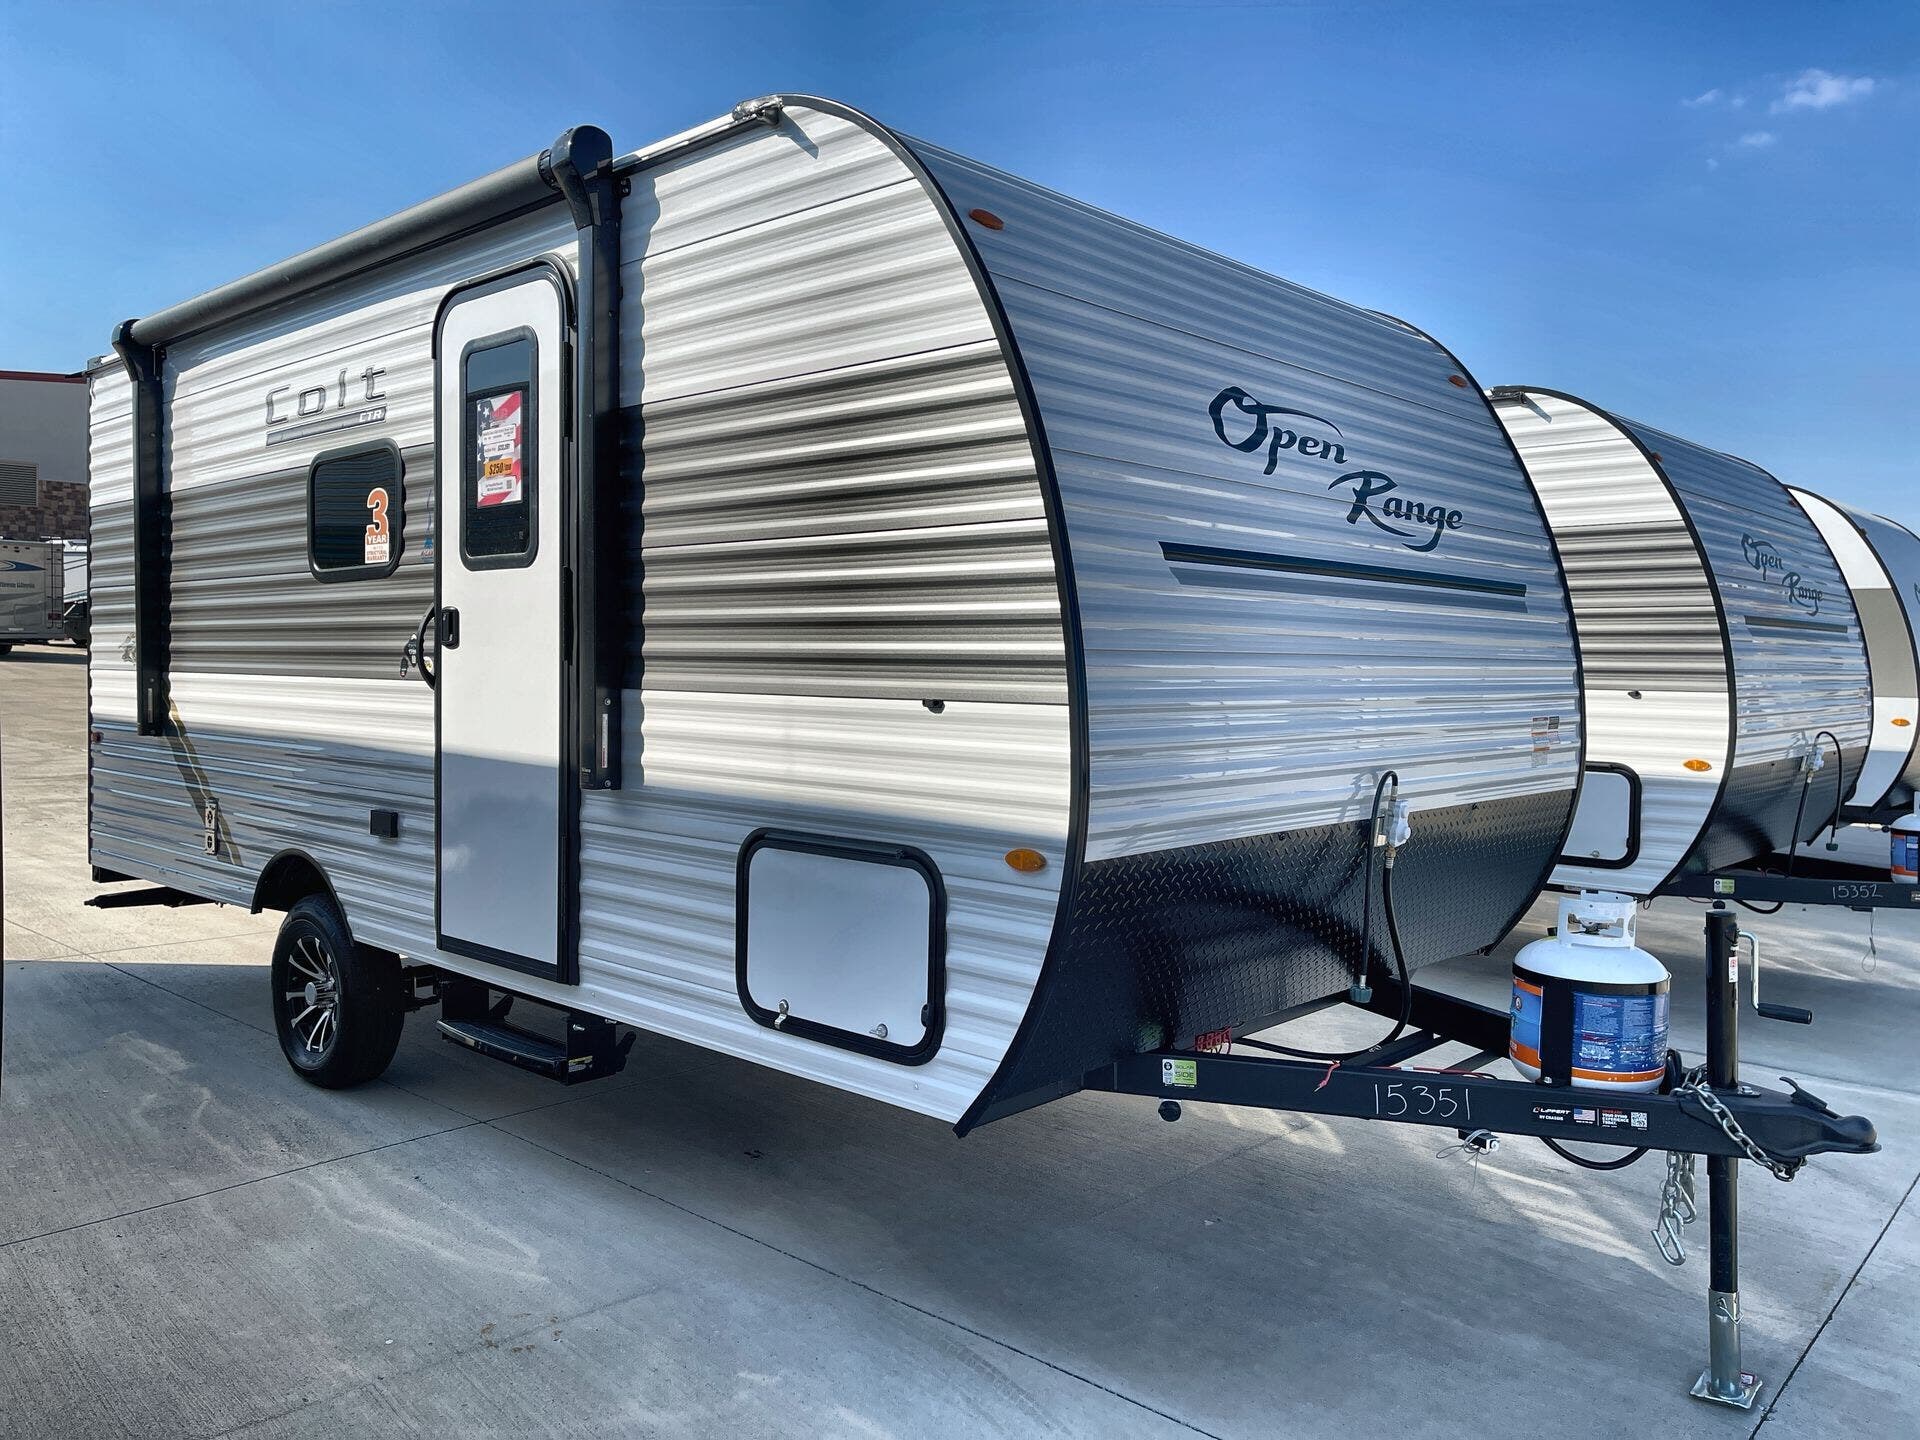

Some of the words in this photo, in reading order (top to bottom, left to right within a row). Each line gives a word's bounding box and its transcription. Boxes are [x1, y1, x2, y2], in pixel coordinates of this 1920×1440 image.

[266, 367, 386, 425] Colt
[1208, 386, 1348, 476] Open
[367, 488, 388, 536] 3
[1328, 470, 1463, 552] Range
[367, 535, 387, 544] YEAR
[1741, 533, 1784, 581] Open
[1782, 572, 1824, 616] Range
[1832, 884, 1883, 899] 15352
[1375, 1083, 1470, 1120] 15351
